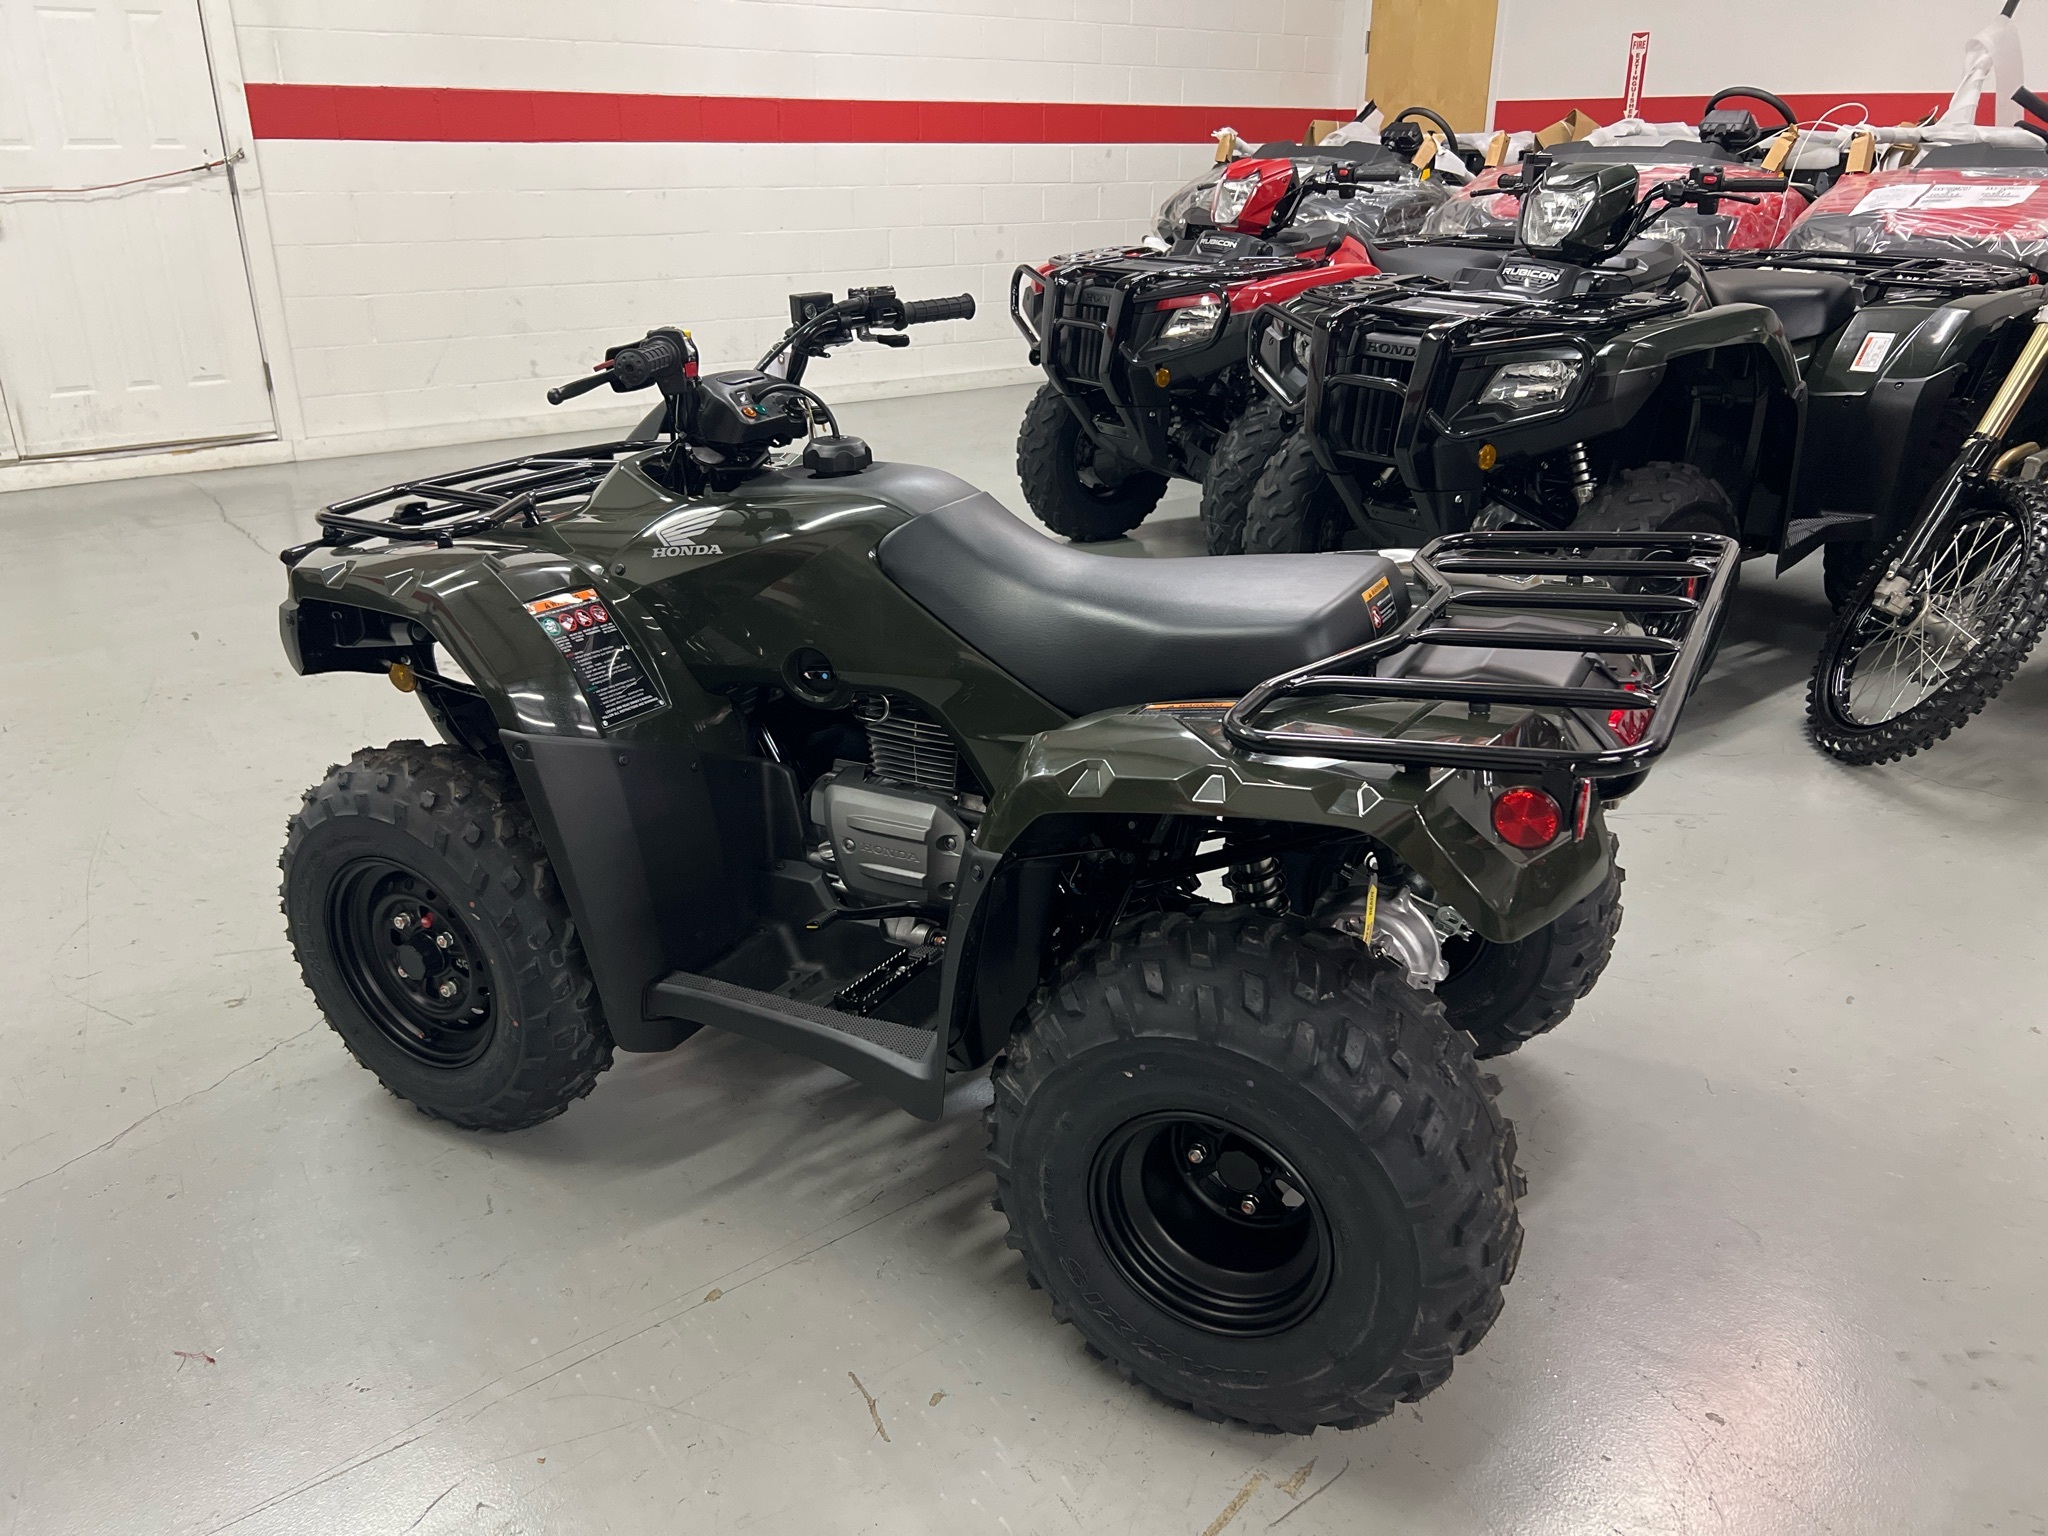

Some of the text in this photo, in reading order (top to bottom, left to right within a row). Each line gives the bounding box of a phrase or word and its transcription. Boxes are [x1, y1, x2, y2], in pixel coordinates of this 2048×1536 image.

[1632, 40, 1646, 50] FIRE
[1200, 238, 1238, 249] RUBICON
[1502, 267, 1560, 282] RUBICON
[1366, 341, 1417, 358] HOND
[651, 544, 724, 559] HONDA
[860, 842, 920, 863] HONDA
